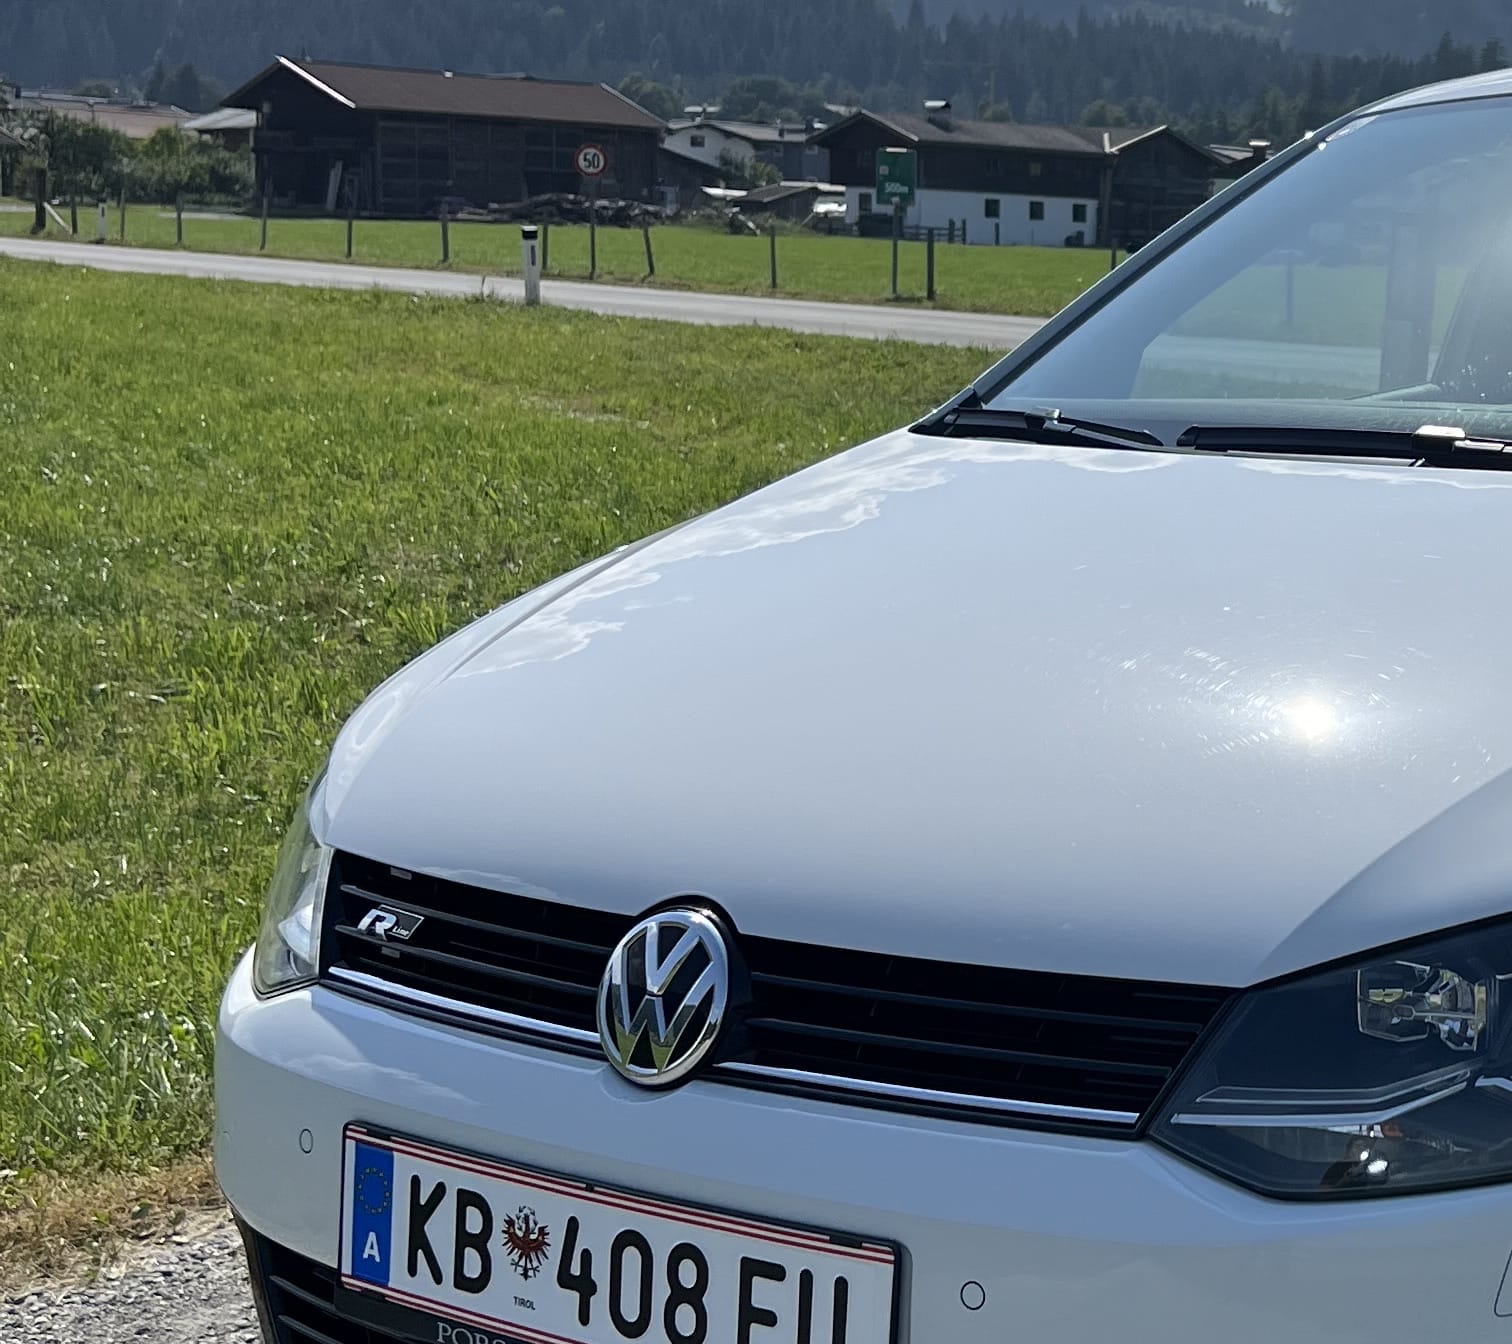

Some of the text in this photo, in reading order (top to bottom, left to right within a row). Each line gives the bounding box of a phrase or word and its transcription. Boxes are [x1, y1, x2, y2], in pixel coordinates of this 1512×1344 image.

[583, 152, 600, 168] 50
[407, 1174, 494, 1294] KB
[362, 1231, 381, 1264] A
[513, 1295, 536, 1310] TIROL
